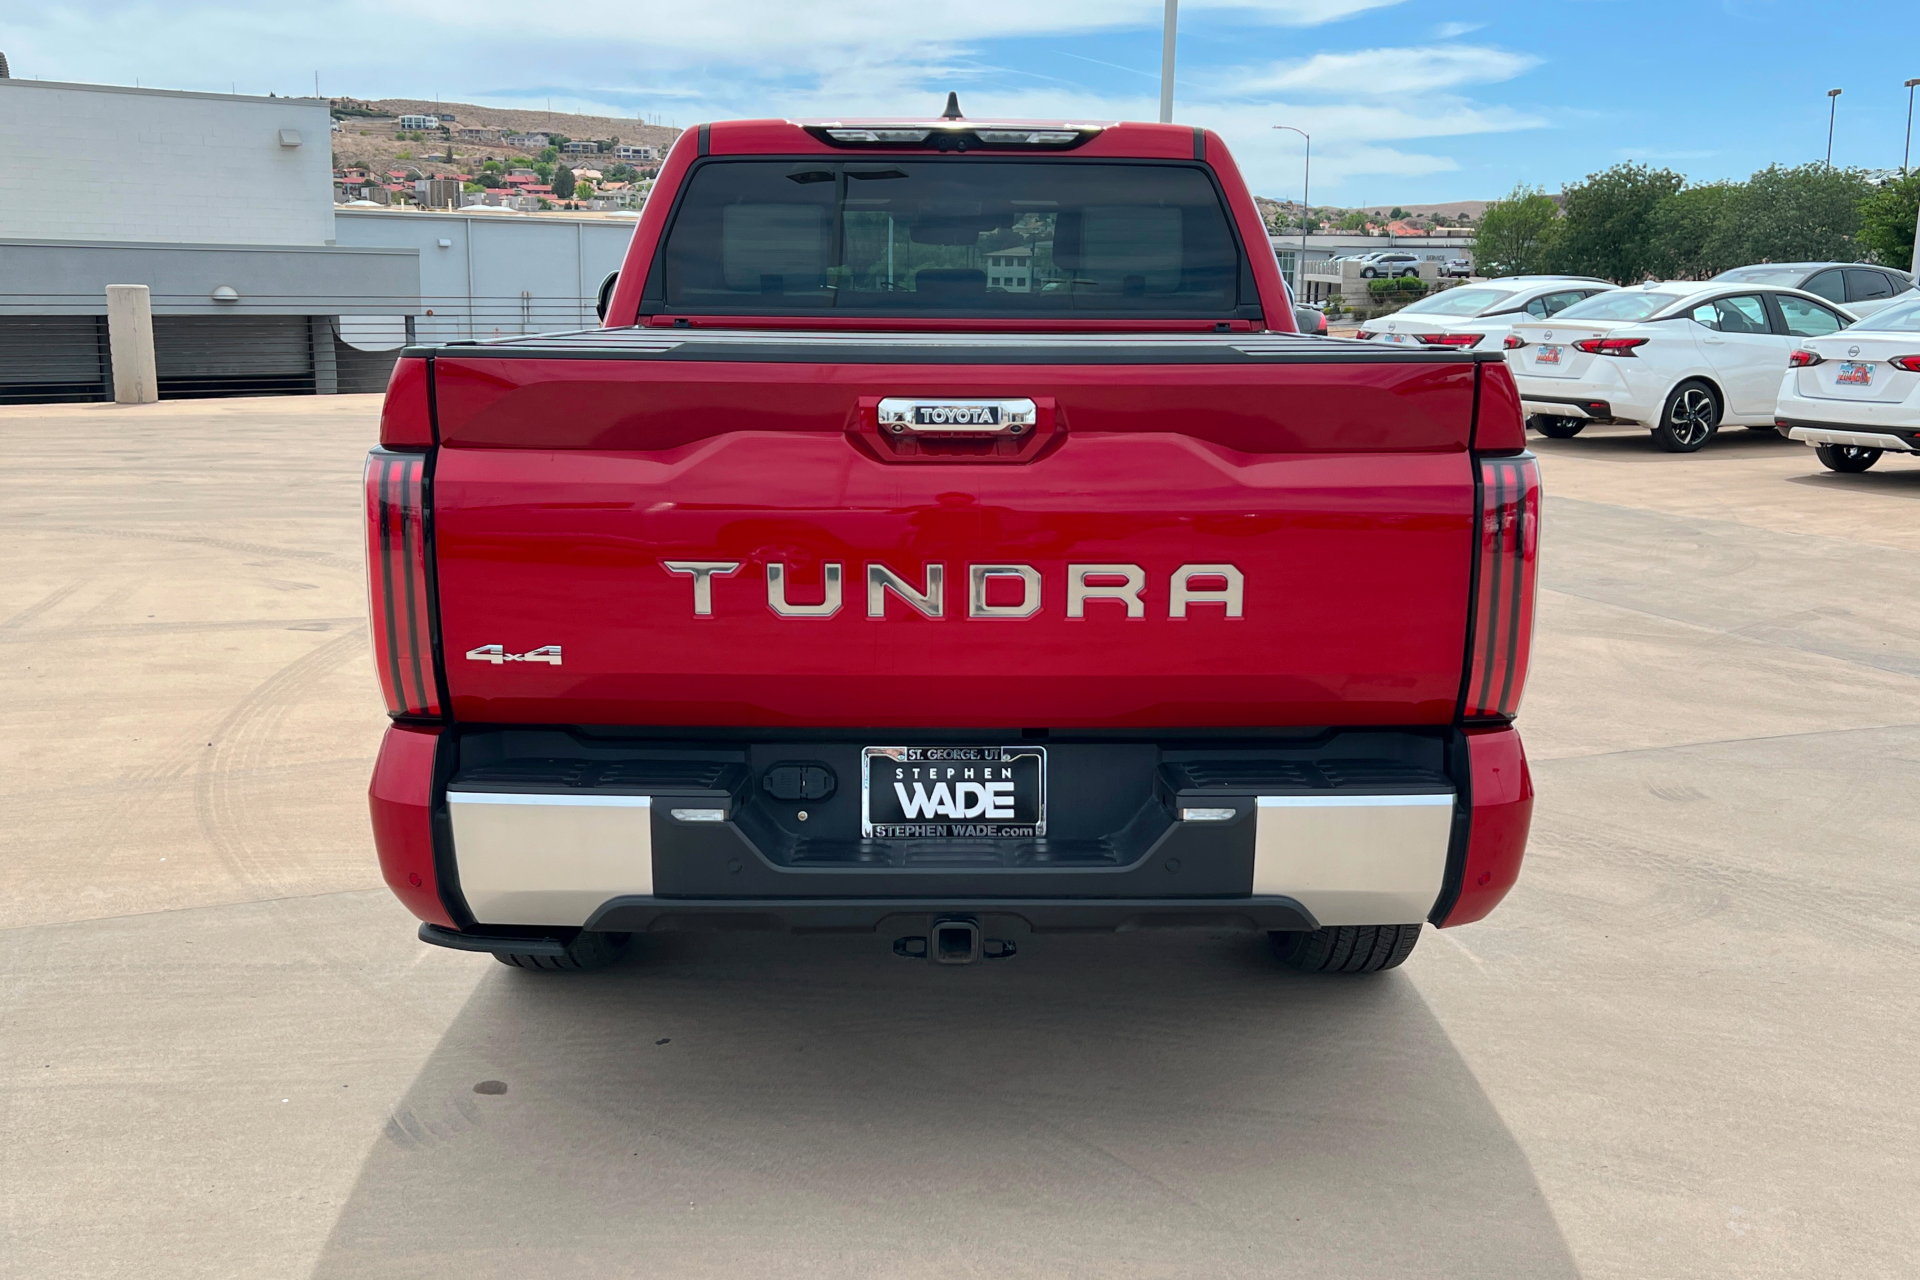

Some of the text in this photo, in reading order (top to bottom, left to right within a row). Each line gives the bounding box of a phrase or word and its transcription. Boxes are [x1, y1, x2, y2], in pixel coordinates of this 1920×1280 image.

[920, 408, 994, 423] TOYOTA
[663, 561, 1245, 618] TUNDRA
[466, 644, 562, 665] 4x4
[908, 749, 924, 760] ST.
[985, 749, 1000, 760] UT
[895, 767, 1012, 779] STEPHEN
[893, 782, 1015, 819] WADE
[875, 825, 1033, 837] STEPHEN WADE.com
